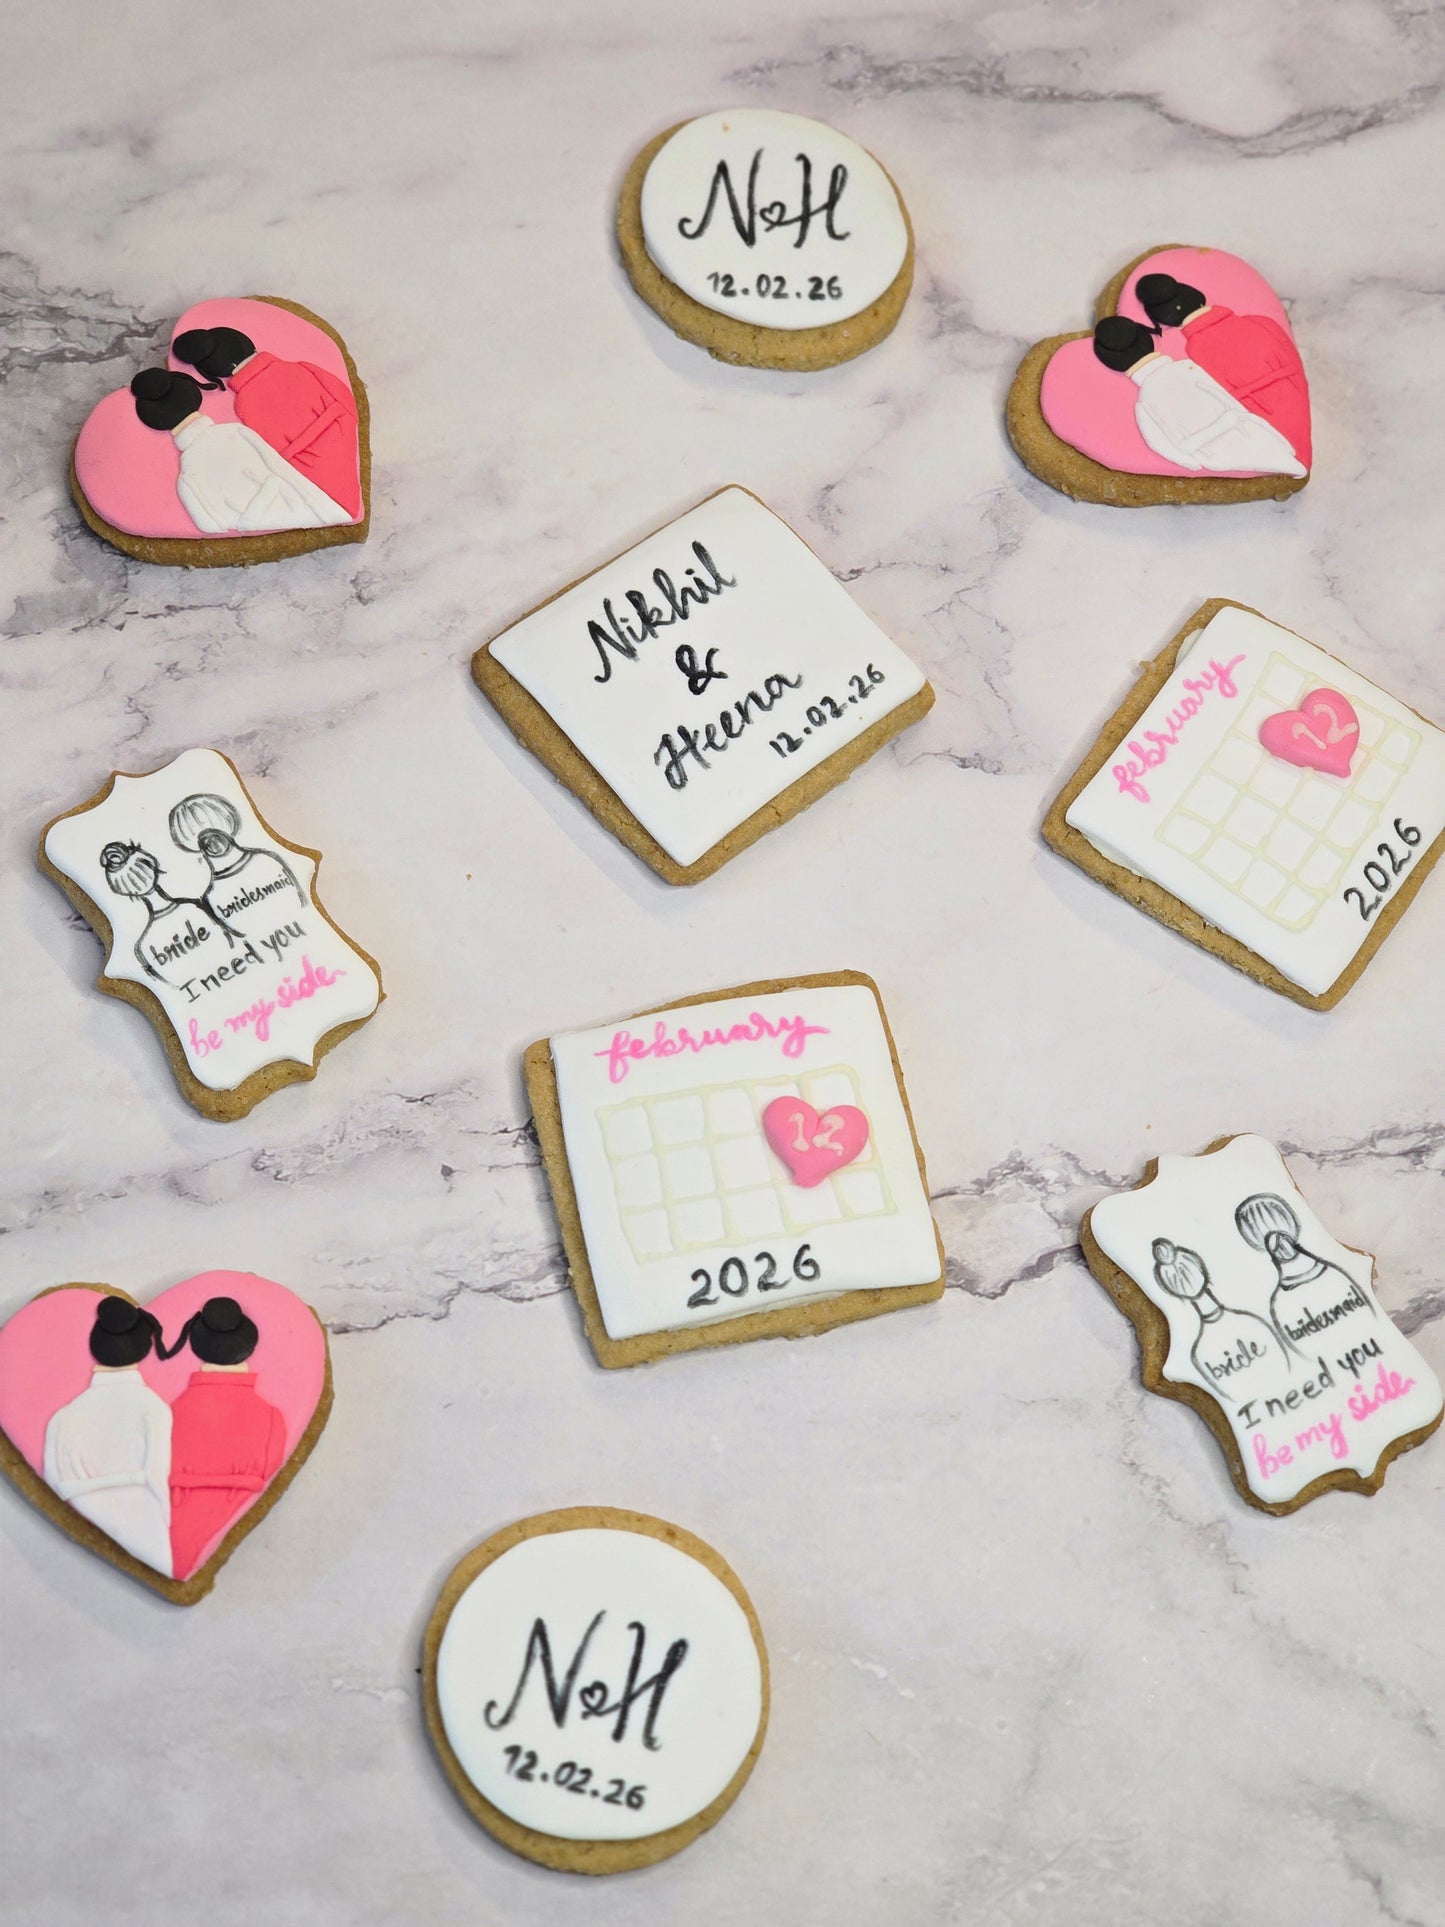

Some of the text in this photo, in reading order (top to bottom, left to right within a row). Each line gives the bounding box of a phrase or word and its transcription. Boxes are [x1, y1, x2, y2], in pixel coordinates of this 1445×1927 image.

[707, 271, 843, 301] 12.02.26
[587, 540, 737, 683] Nikhil
[675, 644, 728, 695] &
[654, 672, 803, 791] Heena
[769, 663, 885, 758] 12.02.26
[1112, 653, 1246, 804] february
[1291, 703, 1359, 751] 12
[217, 868, 295, 919] bridesmaid
[1343, 817, 1422, 921] 2026
[149, 919, 211, 967] bride
[179, 920, 307, 1004] I need you
[188, 953, 348, 1059] be my side
[593, 1011, 831, 1084] february
[787, 1111, 845, 1157] 12
[687, 1243, 820, 1309] 2026
[1284, 1284, 1368, 1341] bridesmaid
[1204, 1338, 1267, 1381] bride
[1237, 1337, 1384, 1429] I need you
[1252, 1361, 1416, 1480] be my side
[503, 1744, 648, 1812] 12.02.26
